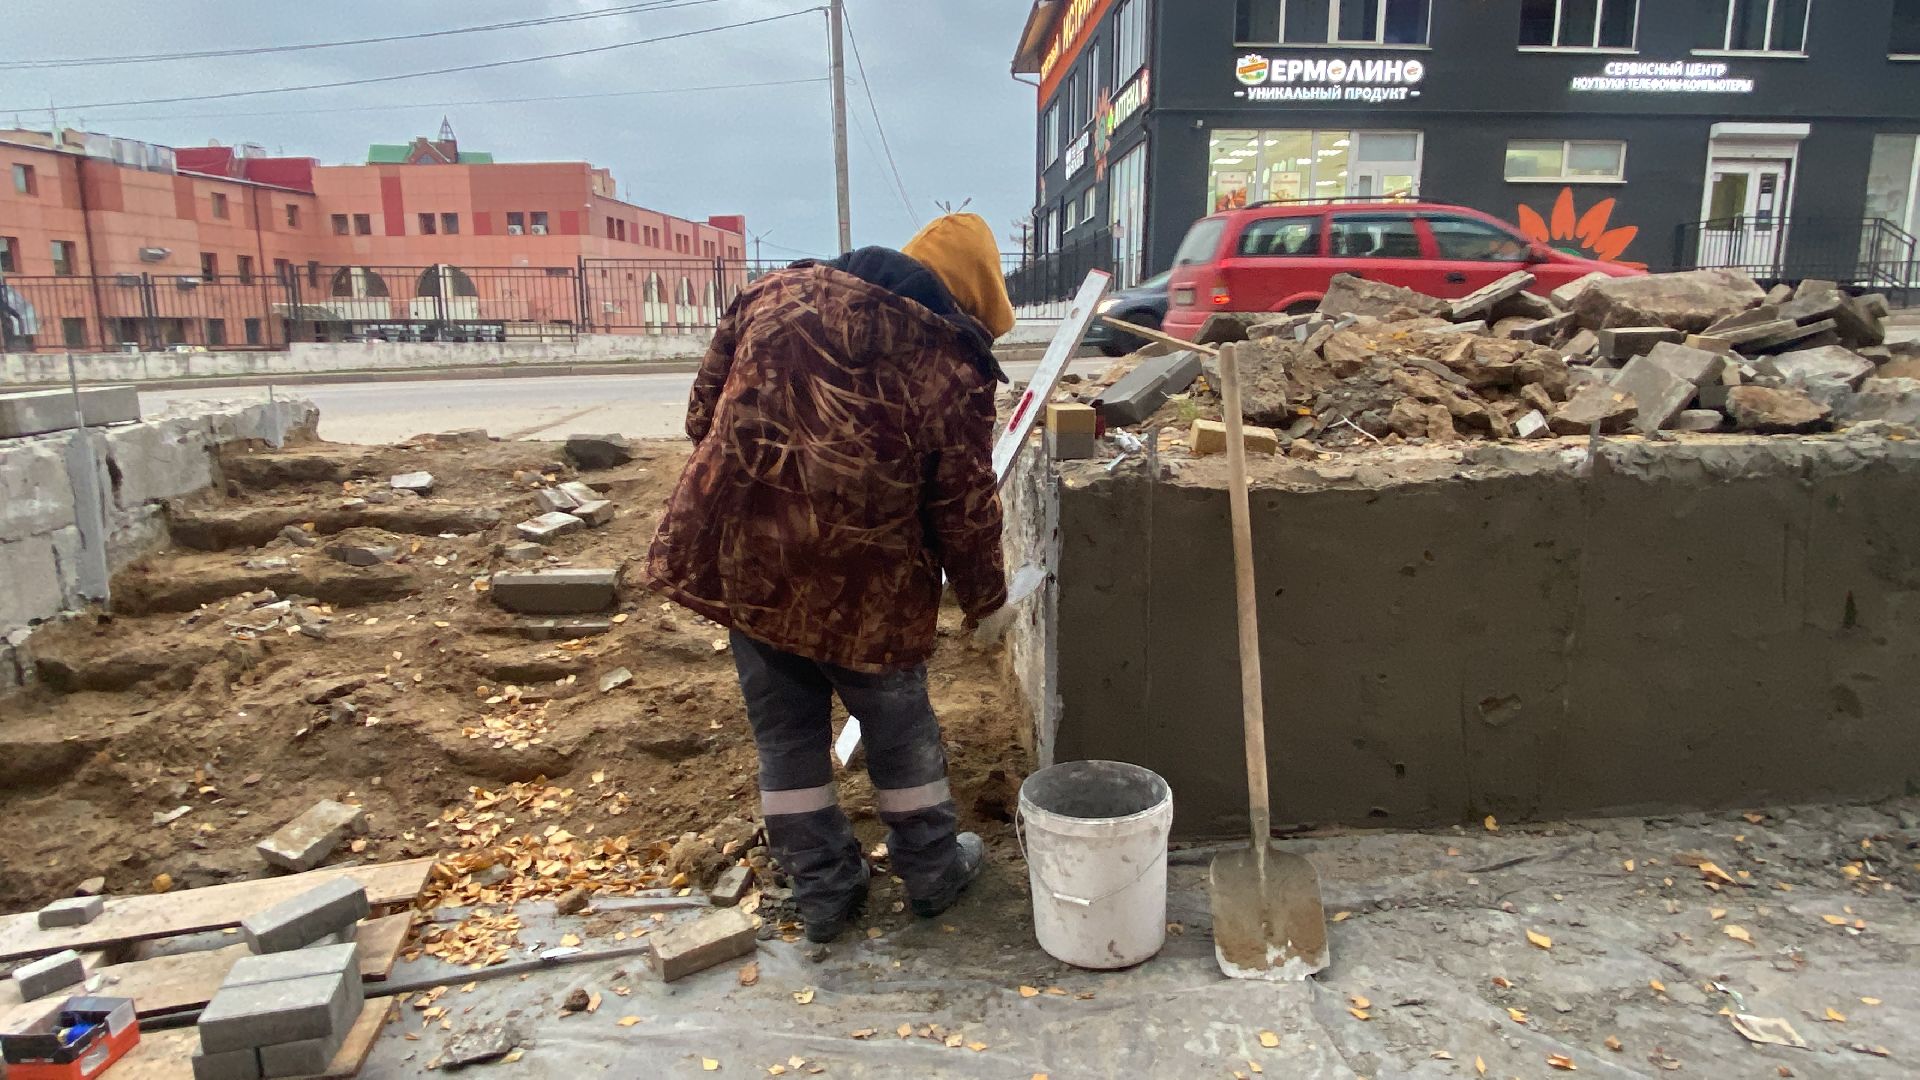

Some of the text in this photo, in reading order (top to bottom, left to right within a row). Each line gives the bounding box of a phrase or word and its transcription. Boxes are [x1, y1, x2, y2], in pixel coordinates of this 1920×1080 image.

[1271, 59, 1424, 82] ЕРМОЛИНО
[1605, 60, 1728, 77] СЕРВИСНЫЙ ЦЕНТР
[1114, 79, 1141, 128] АПТЕКА
[1248, 85, 1409, 102] УНИКАЛЬНЫЙ ПРОДУКТ
